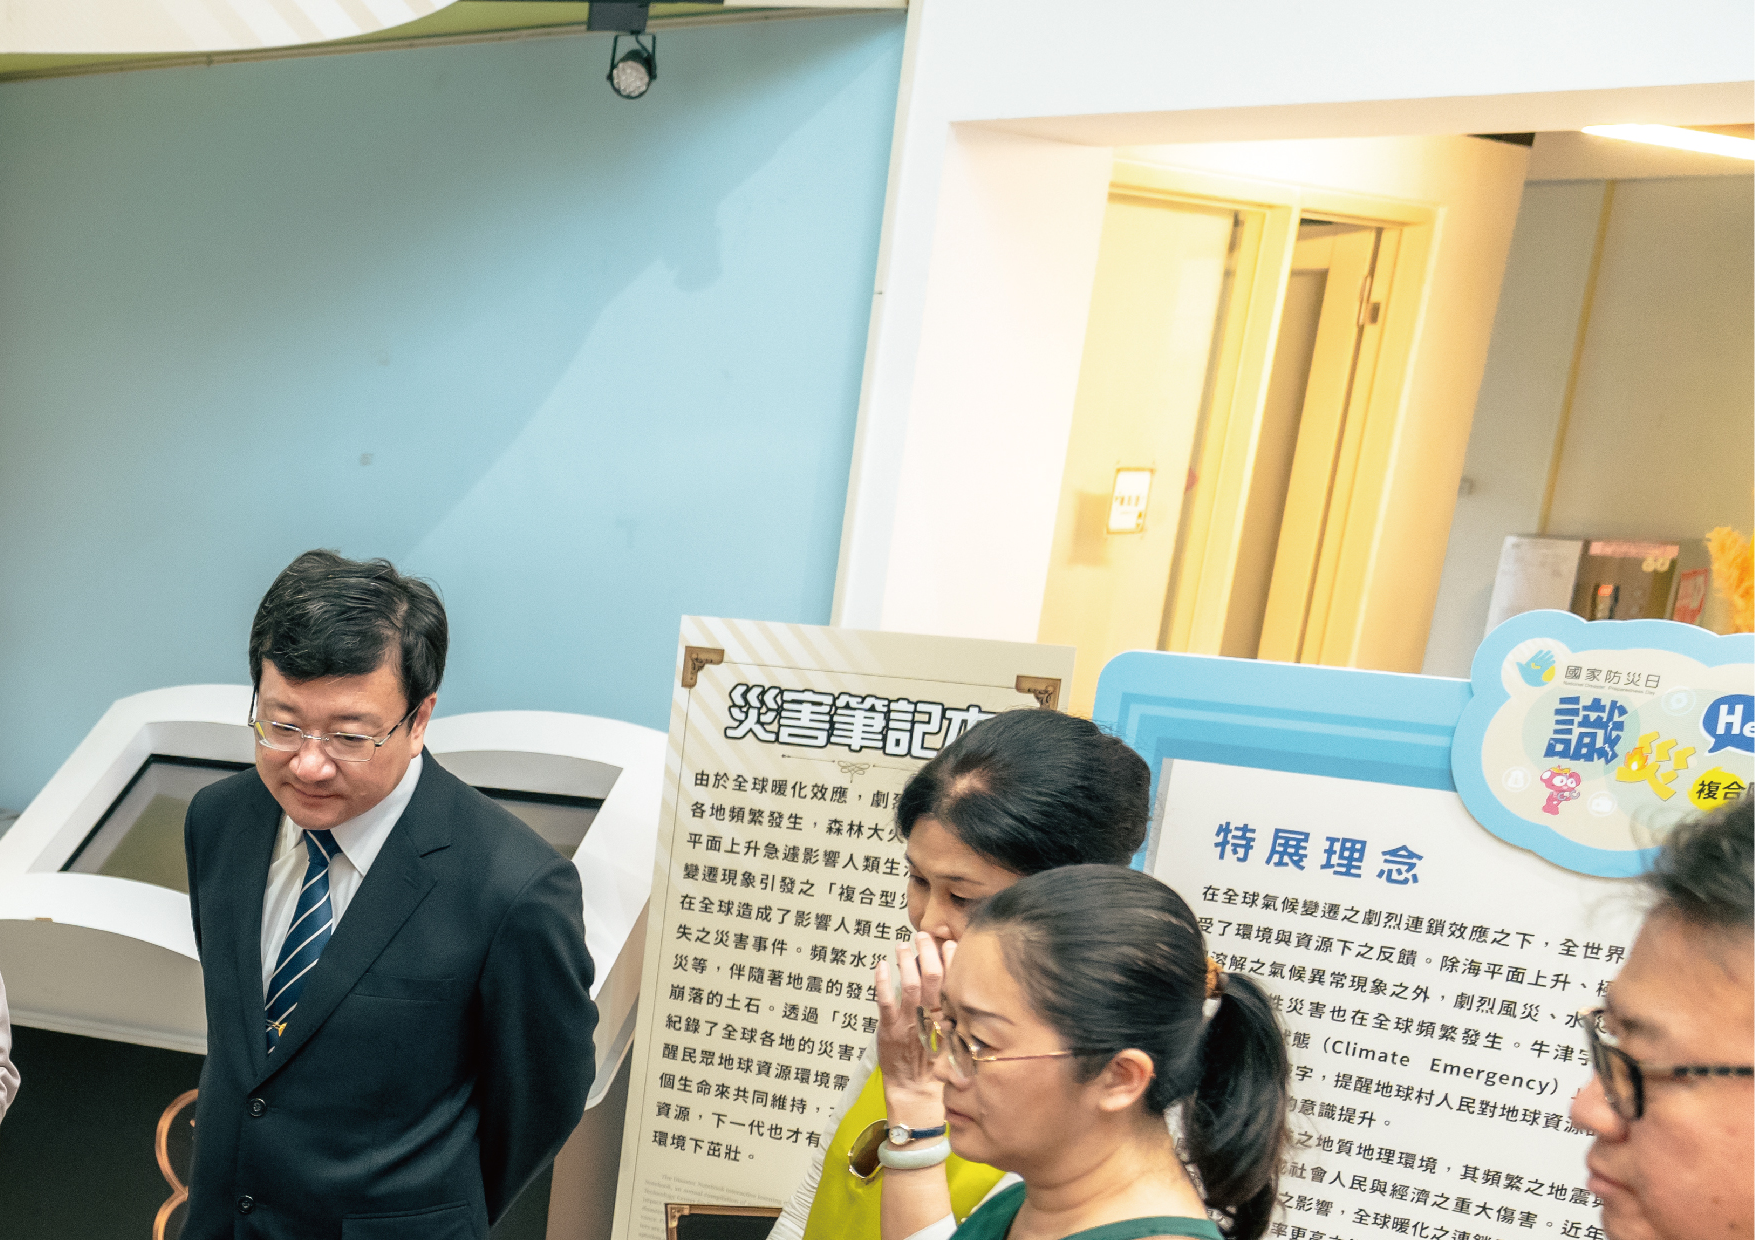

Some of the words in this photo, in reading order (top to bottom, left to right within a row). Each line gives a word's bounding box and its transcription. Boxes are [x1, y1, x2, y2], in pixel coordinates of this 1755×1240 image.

[1565, 665, 1661, 689] 國家防災日
[1695, 780, 1754, 803] 複合
[687, 832, 909, 878] 平面上升急遽影響人類生
[1214, 821, 1424, 885] 特展理念
[679, 894, 913, 943] 在全球造成了影響人類生命
[669, 984, 879, 1034] 崩落的土石。透過「災害
[1205, 950, 1606, 1034] 溶解之氣候異常現象之外，劇烈風災、水
[662, 1042, 850, 1091] 醒民眾地球資源環境需
[658, 1072, 835, 1117] 個生命來共同維持，
[1288, 1063, 1595, 1137] 字，提醒地球村人民對地球資源
[652, 1130, 755, 1163] 環境下茁壯。
[656, 1101, 821, 1149] 資源，下一代也才有
[1289, 1130, 1604, 1208] 之地質地理環境，其頻繁之地震
